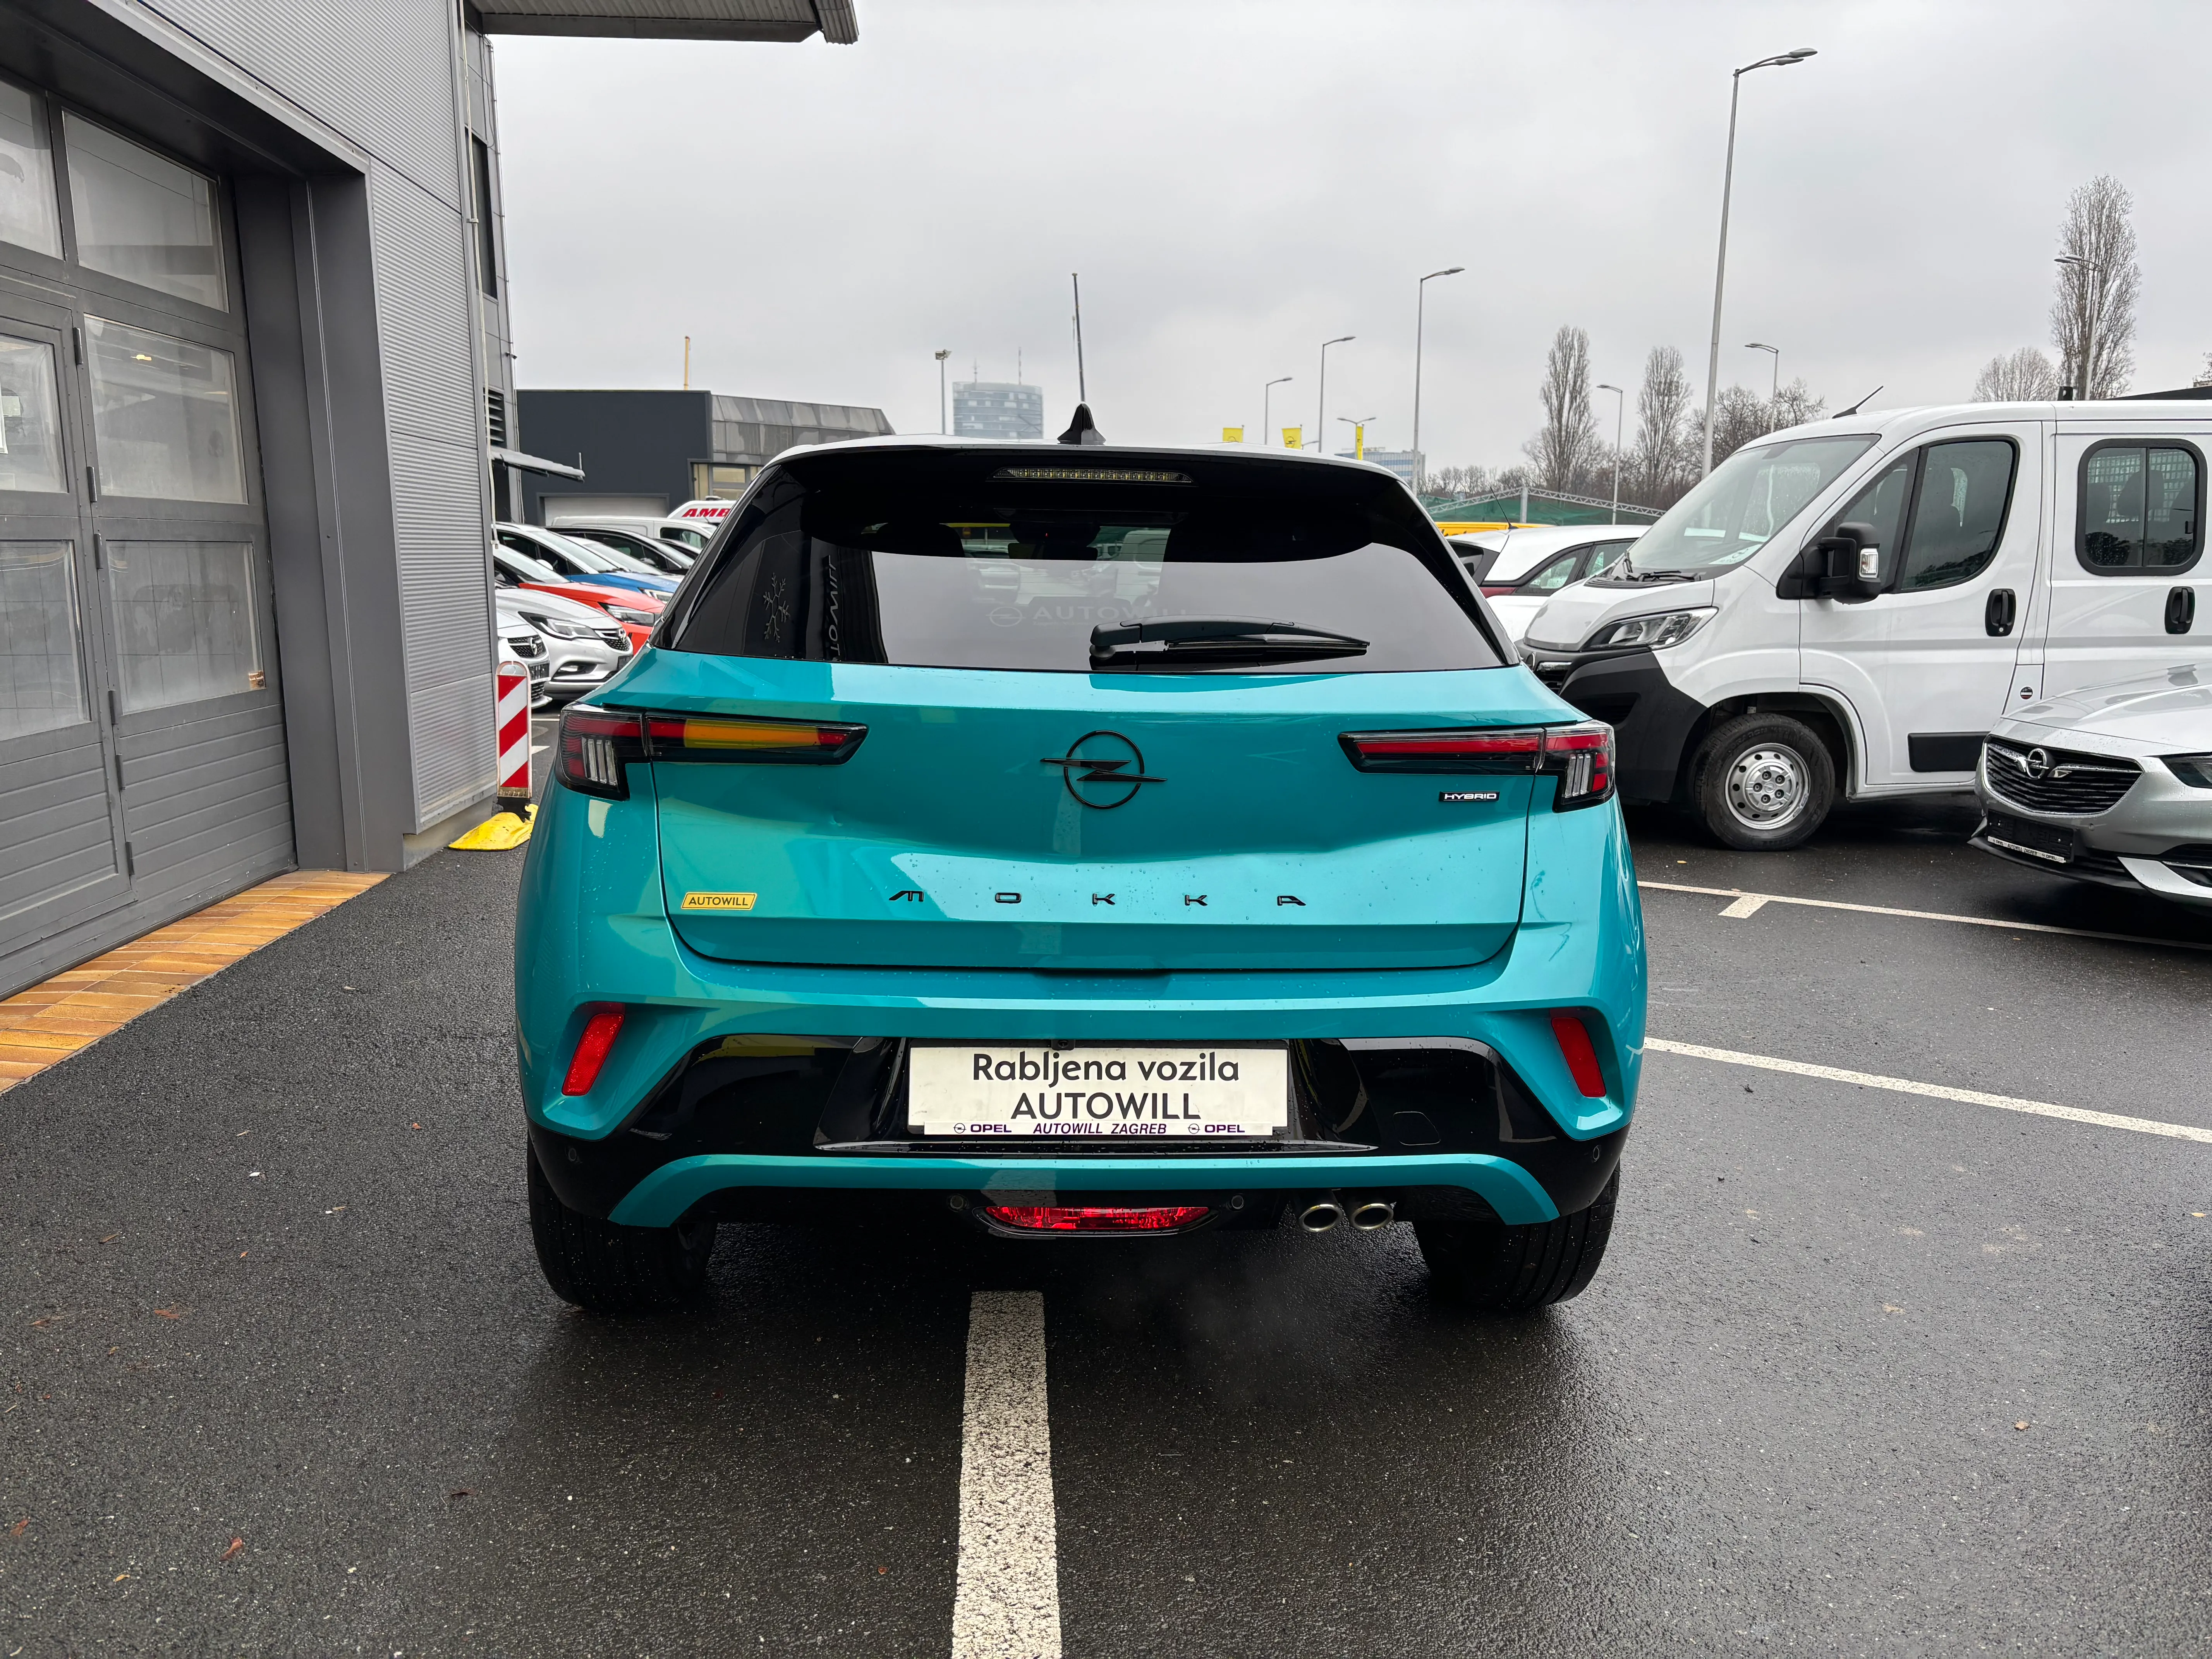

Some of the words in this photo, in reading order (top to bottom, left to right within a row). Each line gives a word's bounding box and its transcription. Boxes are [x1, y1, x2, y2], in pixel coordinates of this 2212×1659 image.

[689, 896, 748, 906] AUTOWILL
[888, 890, 1307, 907] MOKKA
[973, 1051, 1126, 1087] Rabljena
[1137, 1052, 1239, 1081] vozila
[1010, 1092, 1201, 1120] AUTOWILL
[970, 1124, 1012, 1133] OPEL
[1033, 1123, 1103, 1134] AUTOWILL
[1111, 1123, 1167, 1134] ZAGREB
[1204, 1124, 1245, 1133] OPEL
